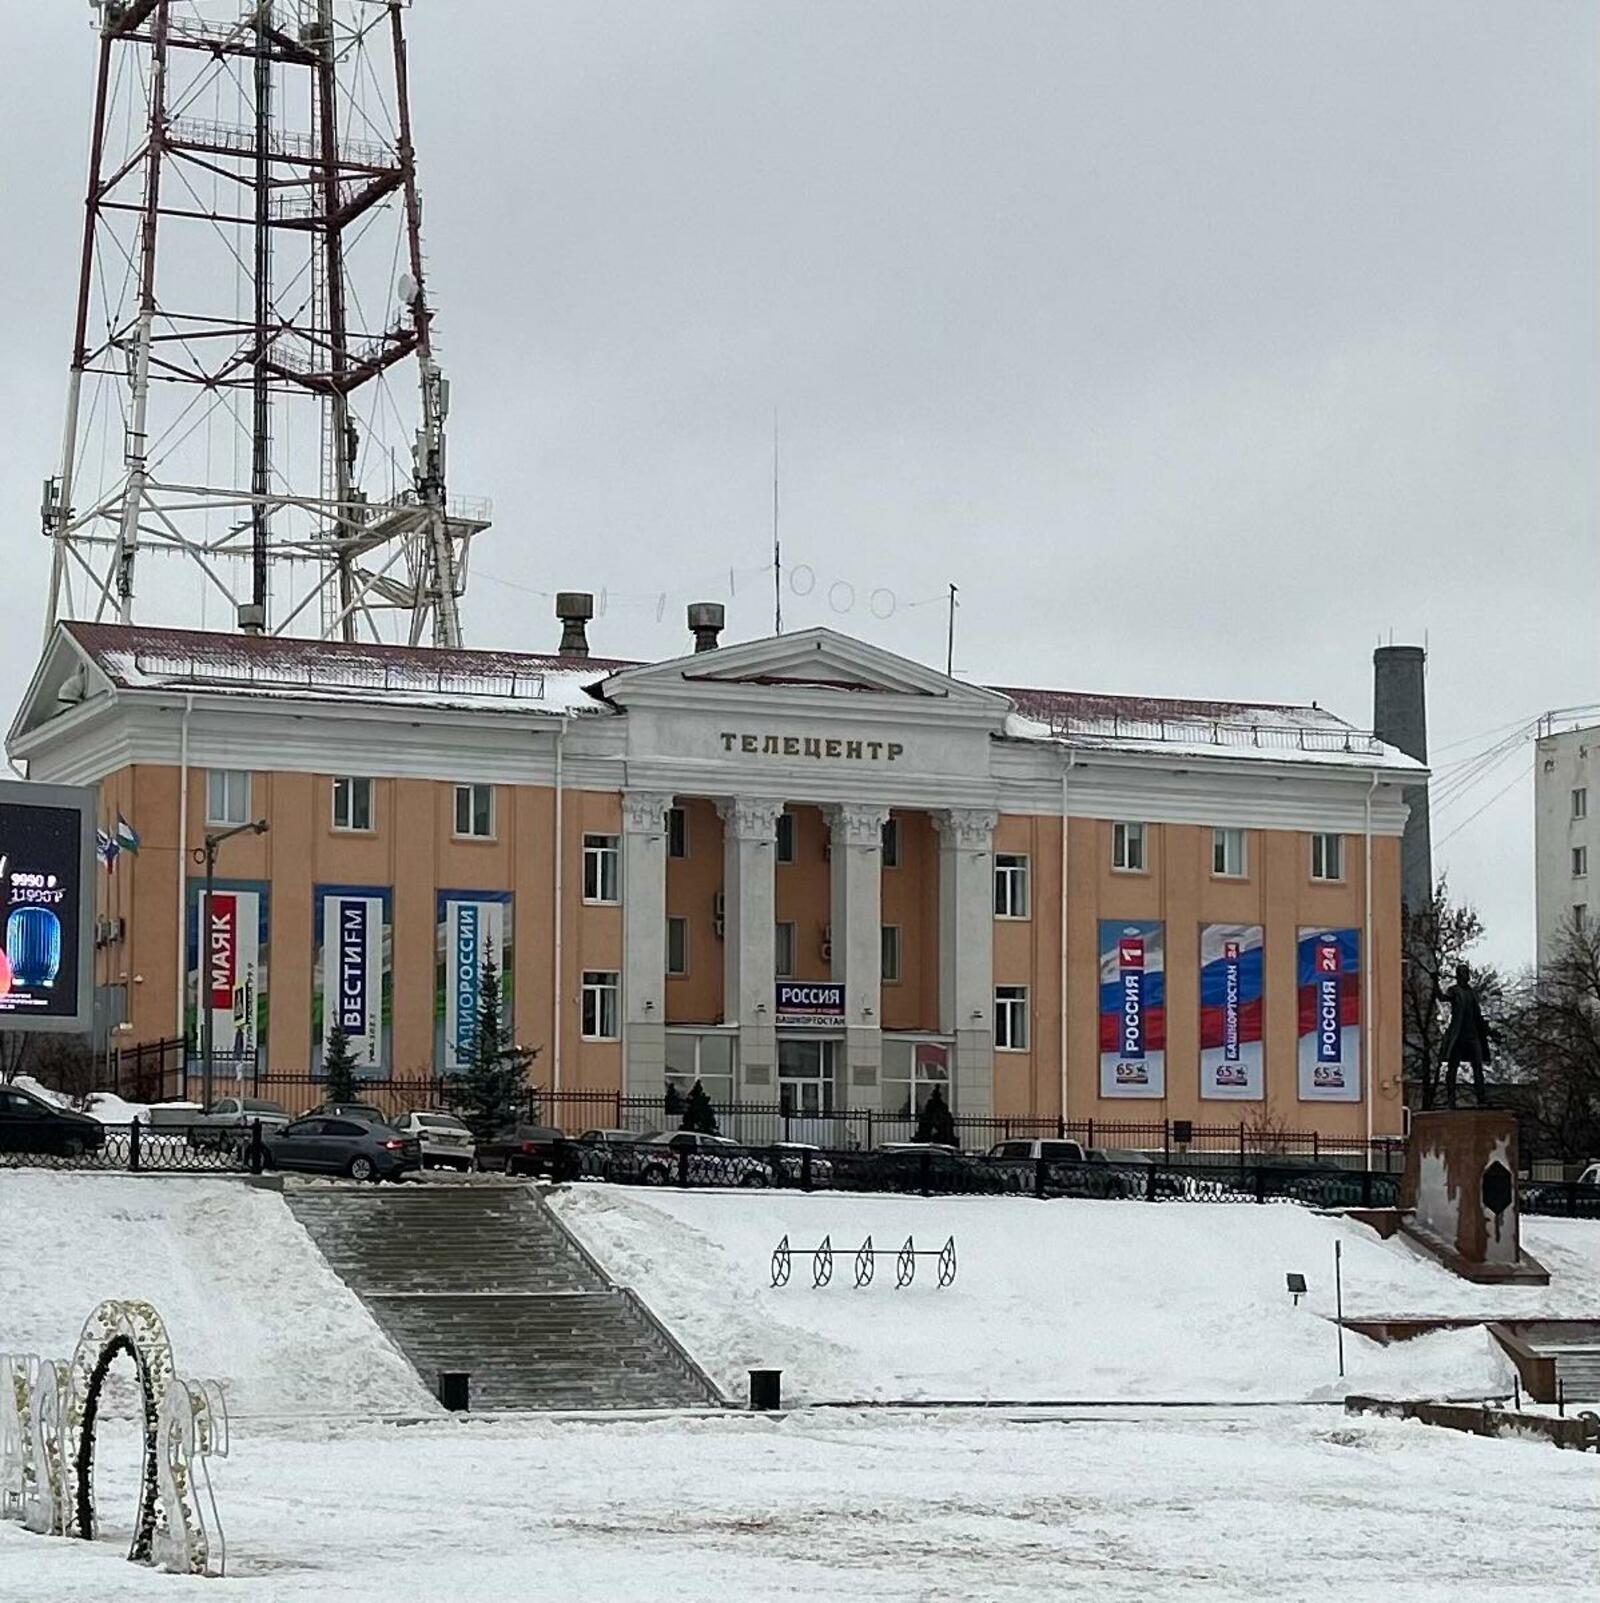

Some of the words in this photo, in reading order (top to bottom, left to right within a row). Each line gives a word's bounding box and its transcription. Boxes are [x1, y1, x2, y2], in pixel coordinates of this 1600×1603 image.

[720, 732, 904, 761] ТЕЛЕЦЕНТР
[211, 912, 231, 991] МАЯК
[1122, 948, 1142, 961] 1
[1322, 947, 1337, 971] 24
[782, 988, 840, 1004] РОССИЯ
[1125, 975, 1139, 1051] РОССИЯ
[1226, 965, 1237, 1059] БАШКОРТОСТАН
[1322, 981, 1336, 1056] РОССИЯ
[1116, 1063, 1133, 1076] 65
[1216, 1064, 1232, 1076] 65
[1314, 1067, 1329, 1079] 65
